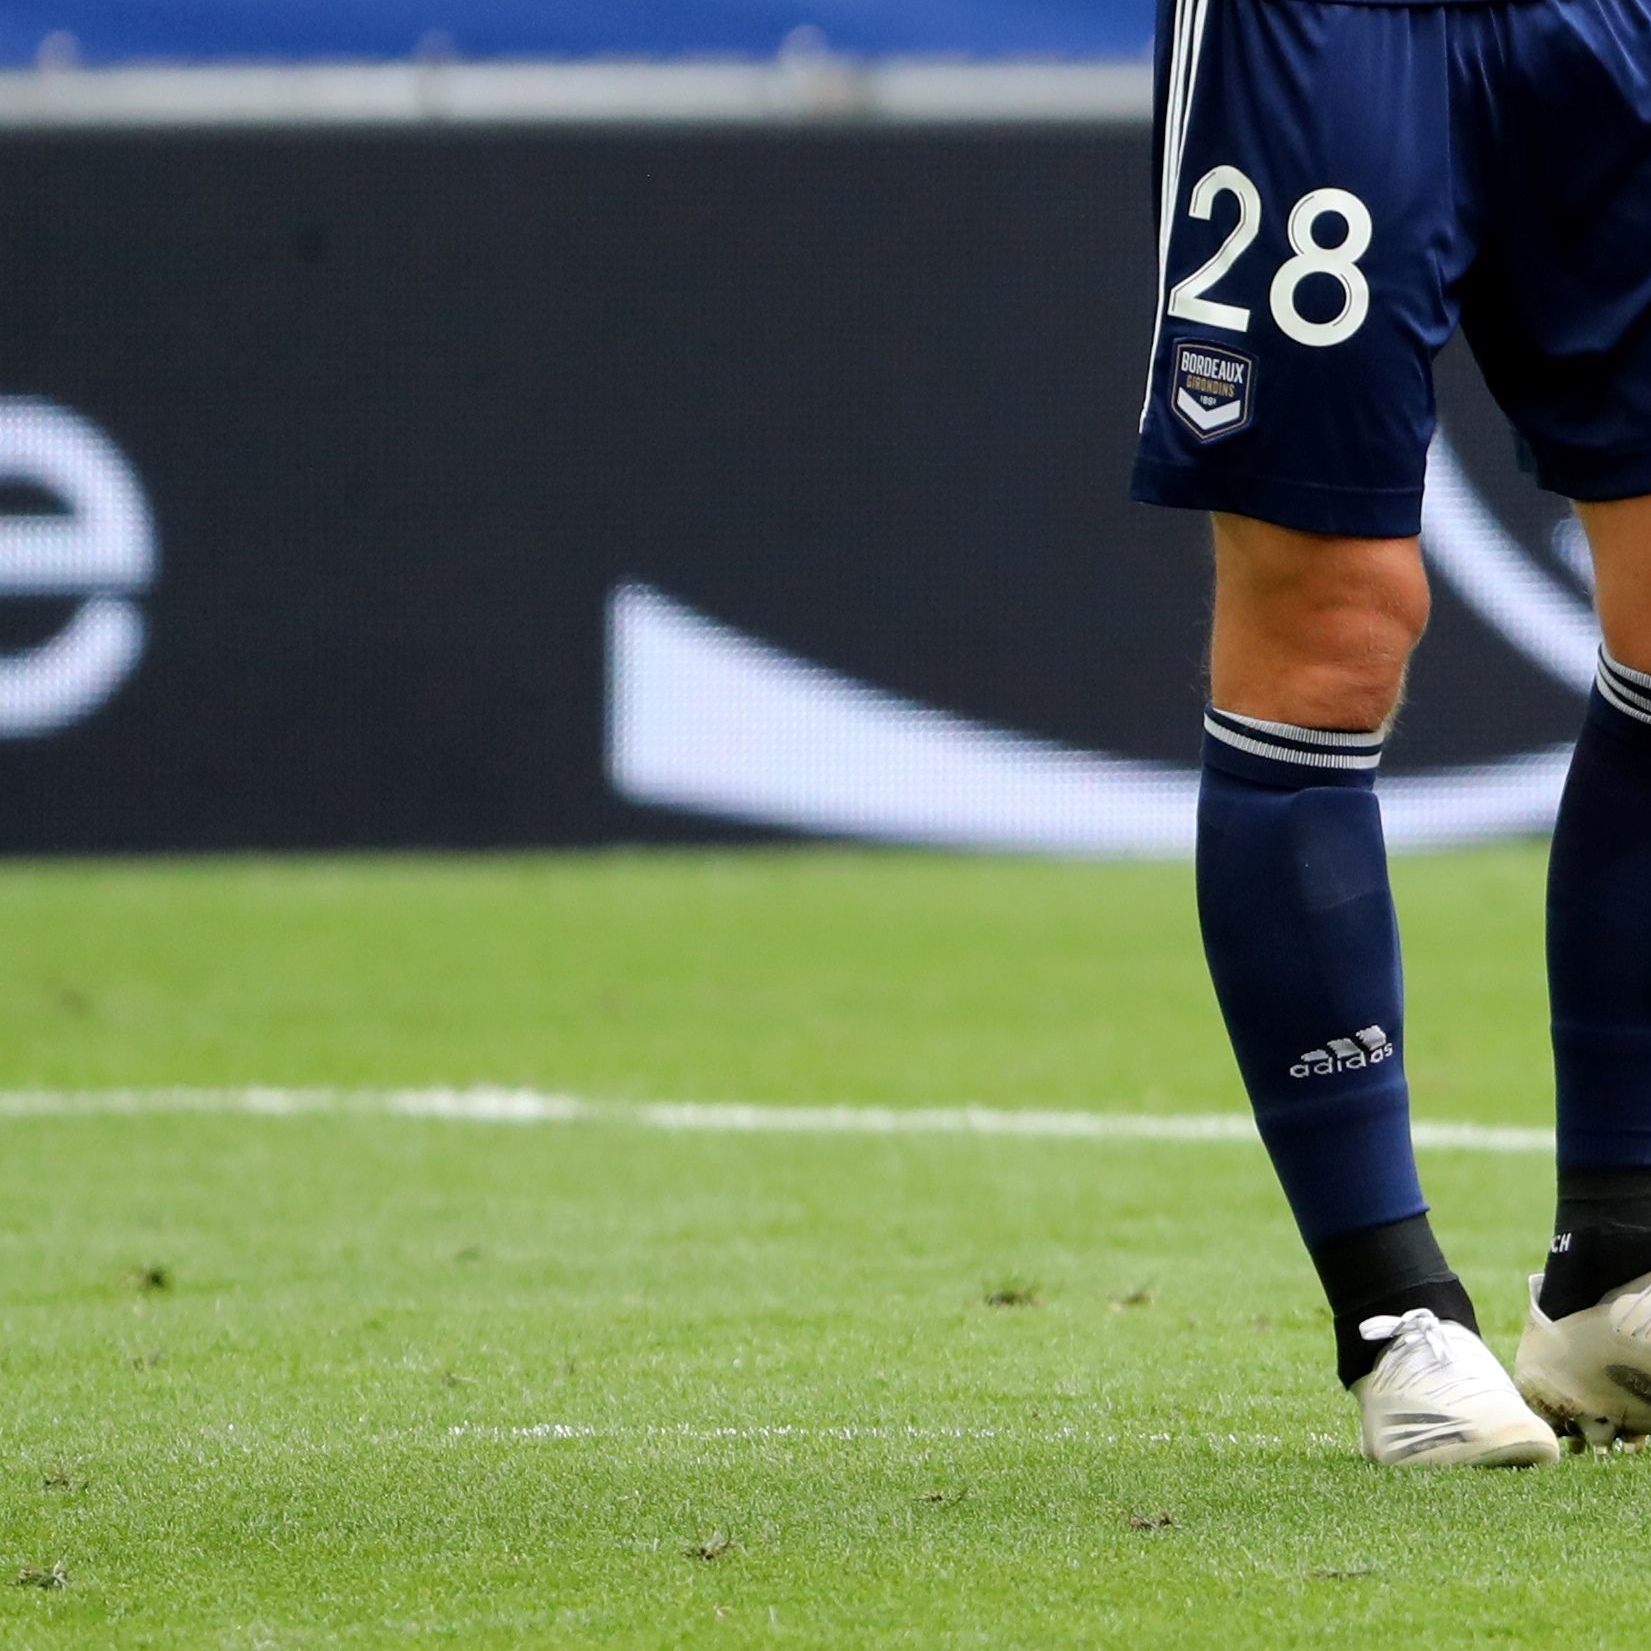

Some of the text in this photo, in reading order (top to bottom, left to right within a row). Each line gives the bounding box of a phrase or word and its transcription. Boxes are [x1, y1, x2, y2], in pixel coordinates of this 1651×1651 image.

[1168, 165, 1373, 347] 28
[1181, 351, 1244, 384] BORDEAUX
[1290, 1043, 1392, 1078] adidas
